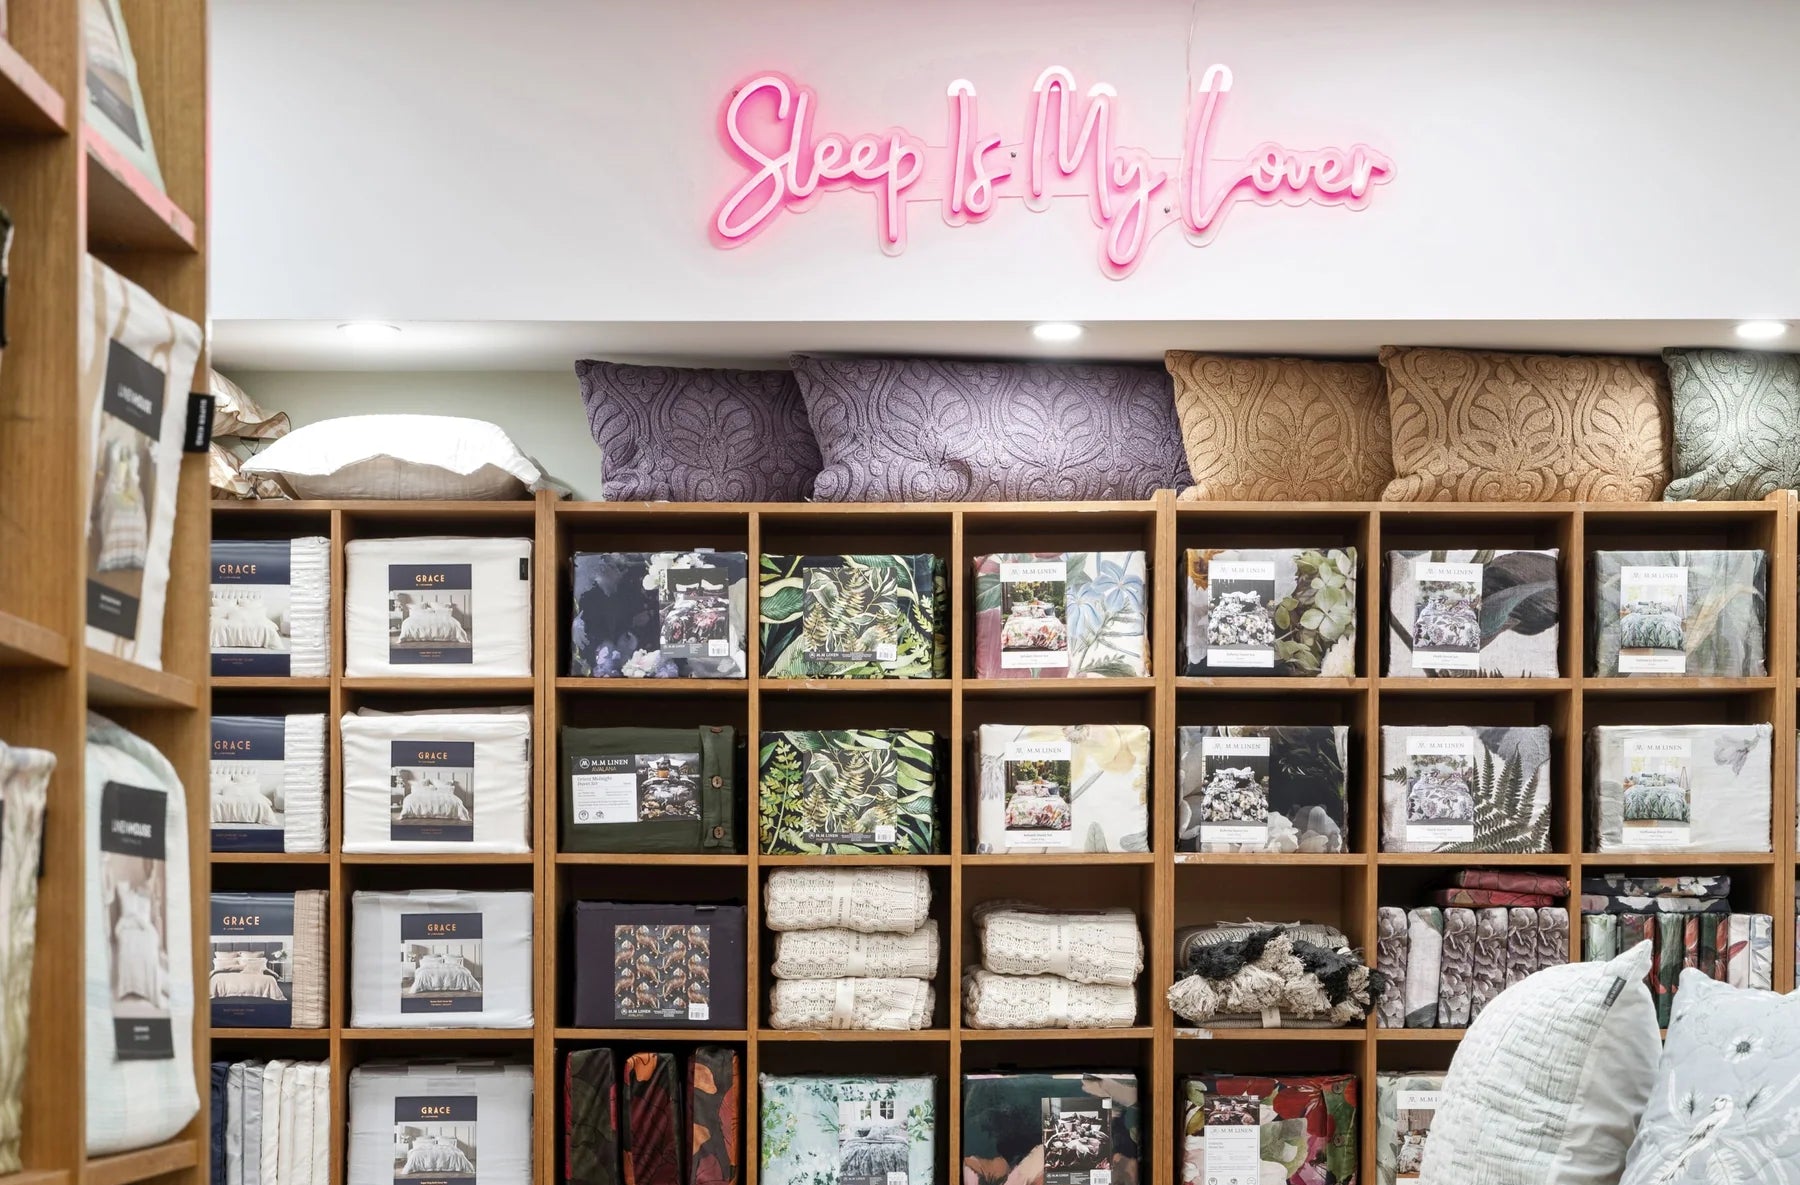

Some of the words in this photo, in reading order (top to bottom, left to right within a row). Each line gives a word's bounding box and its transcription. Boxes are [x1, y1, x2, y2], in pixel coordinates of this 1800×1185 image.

[717, 75, 925, 242] Sleep
[951, 84, 1012, 214] Is
[1031, 71, 1168, 265] My
[1189, 67, 1391, 231] Lover
[219, 564, 257, 574] GRACE
[415, 574, 445, 583] GRACE
[214, 740, 251, 750] GRACE
[418, 751, 448, 760] GRACE
[223, 916, 260, 926] GRACE
[427, 923, 457, 931] GRACE
[421, 1106, 451, 1115] GRACE
